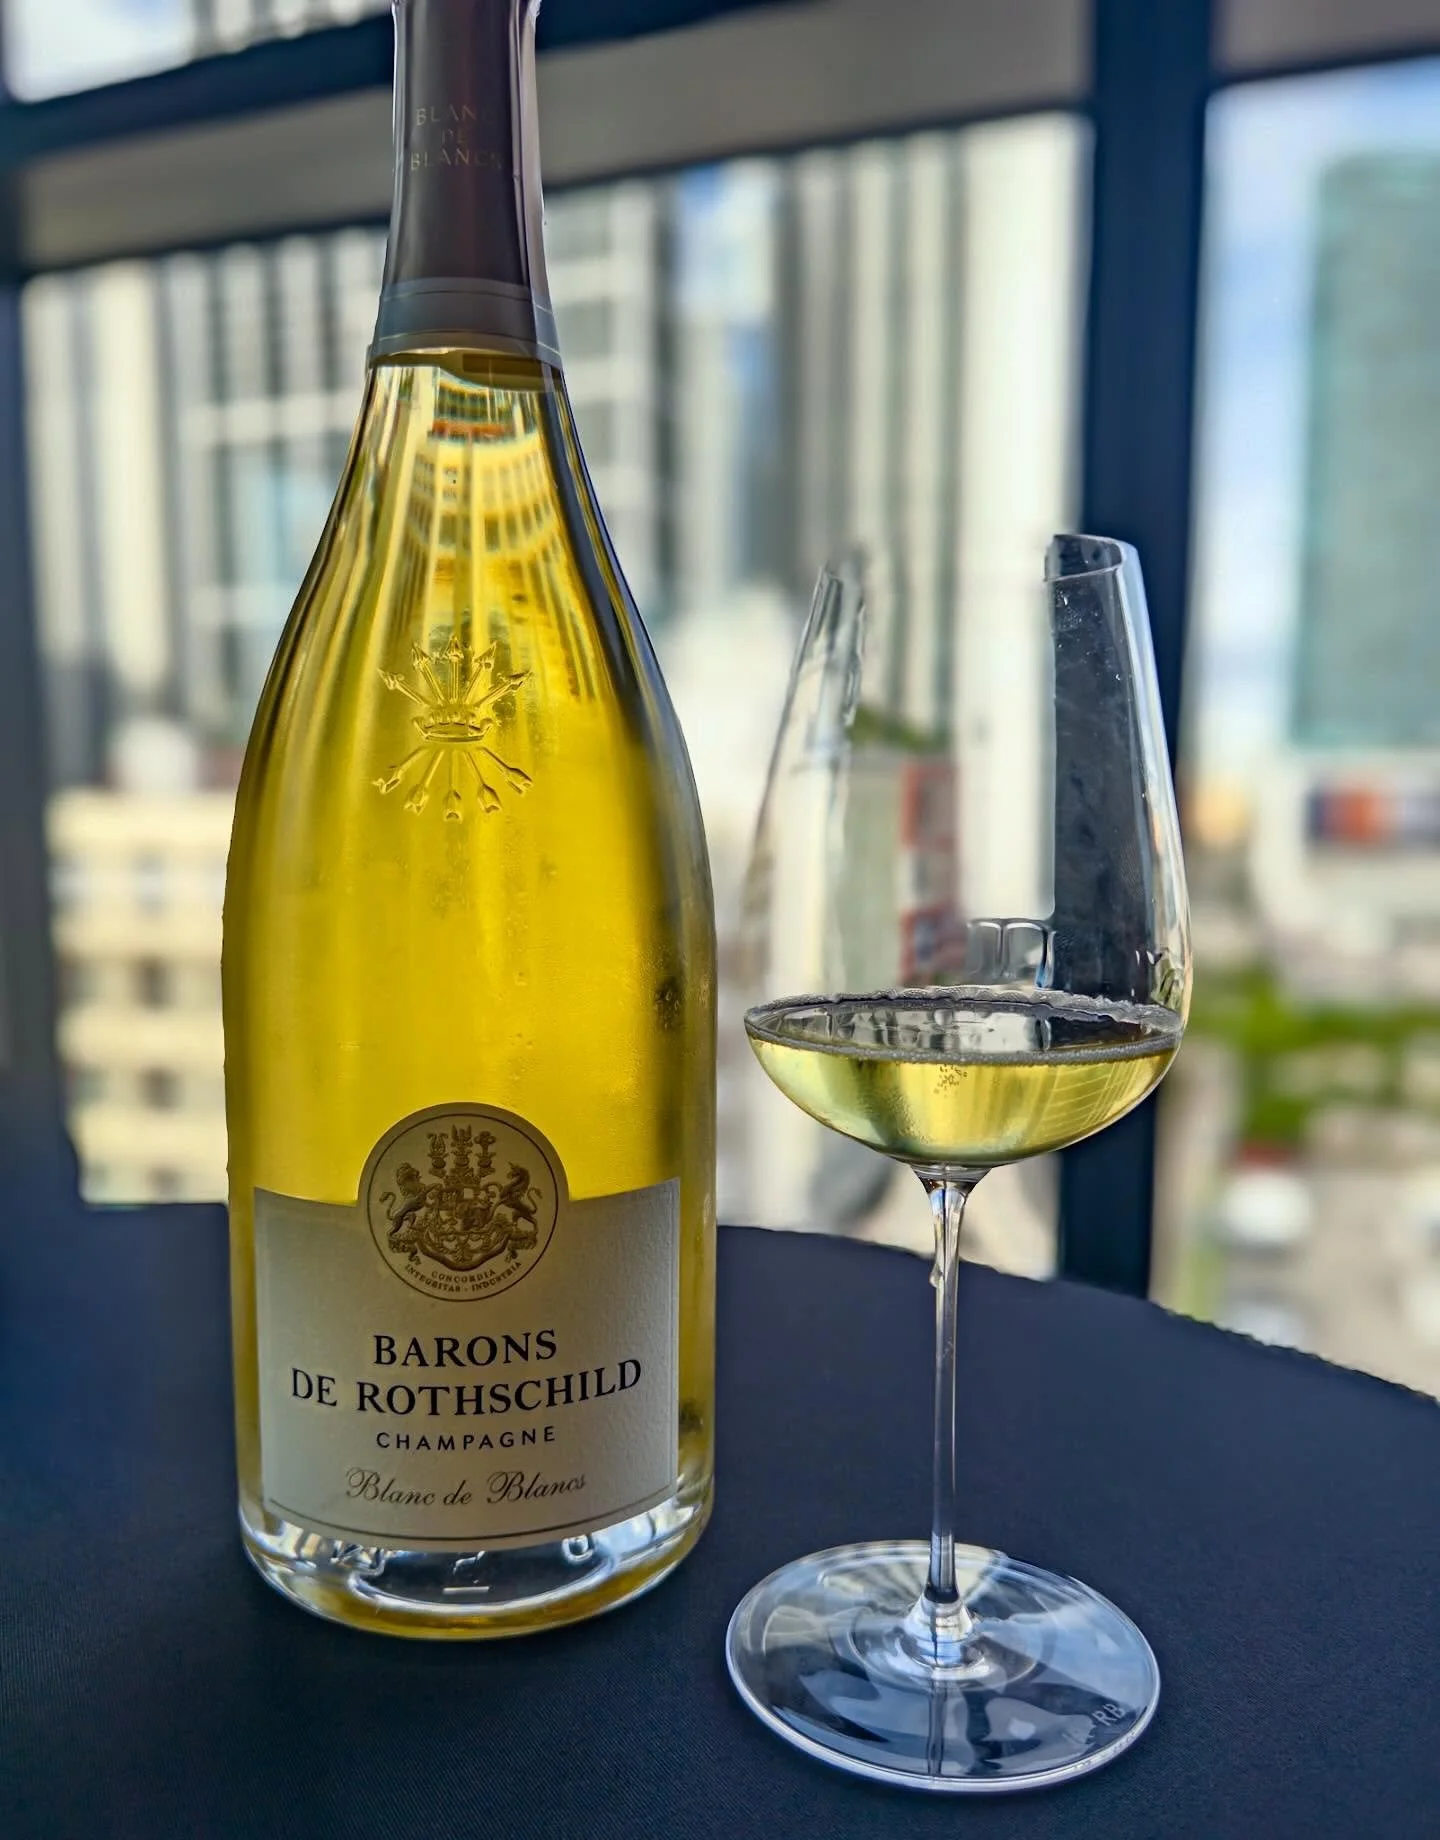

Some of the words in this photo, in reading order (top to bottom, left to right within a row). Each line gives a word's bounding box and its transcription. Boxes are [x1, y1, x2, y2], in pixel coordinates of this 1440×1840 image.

[416, 103, 497, 126] BLAN
[431, 1269, 496, 1283] CONCORDIA
[374, 1329, 557, 1368] BARONS
[291, 1367, 338, 1407] DE
[356, 1358, 642, 1416] ROTHSCHILD
[376, 1425, 556, 1451] CHAMPAGNE
[345, 1466, 435, 1506] Blanc
[442, 1479, 473, 1505] de
[486, 1471, 586, 1503] Blancs
